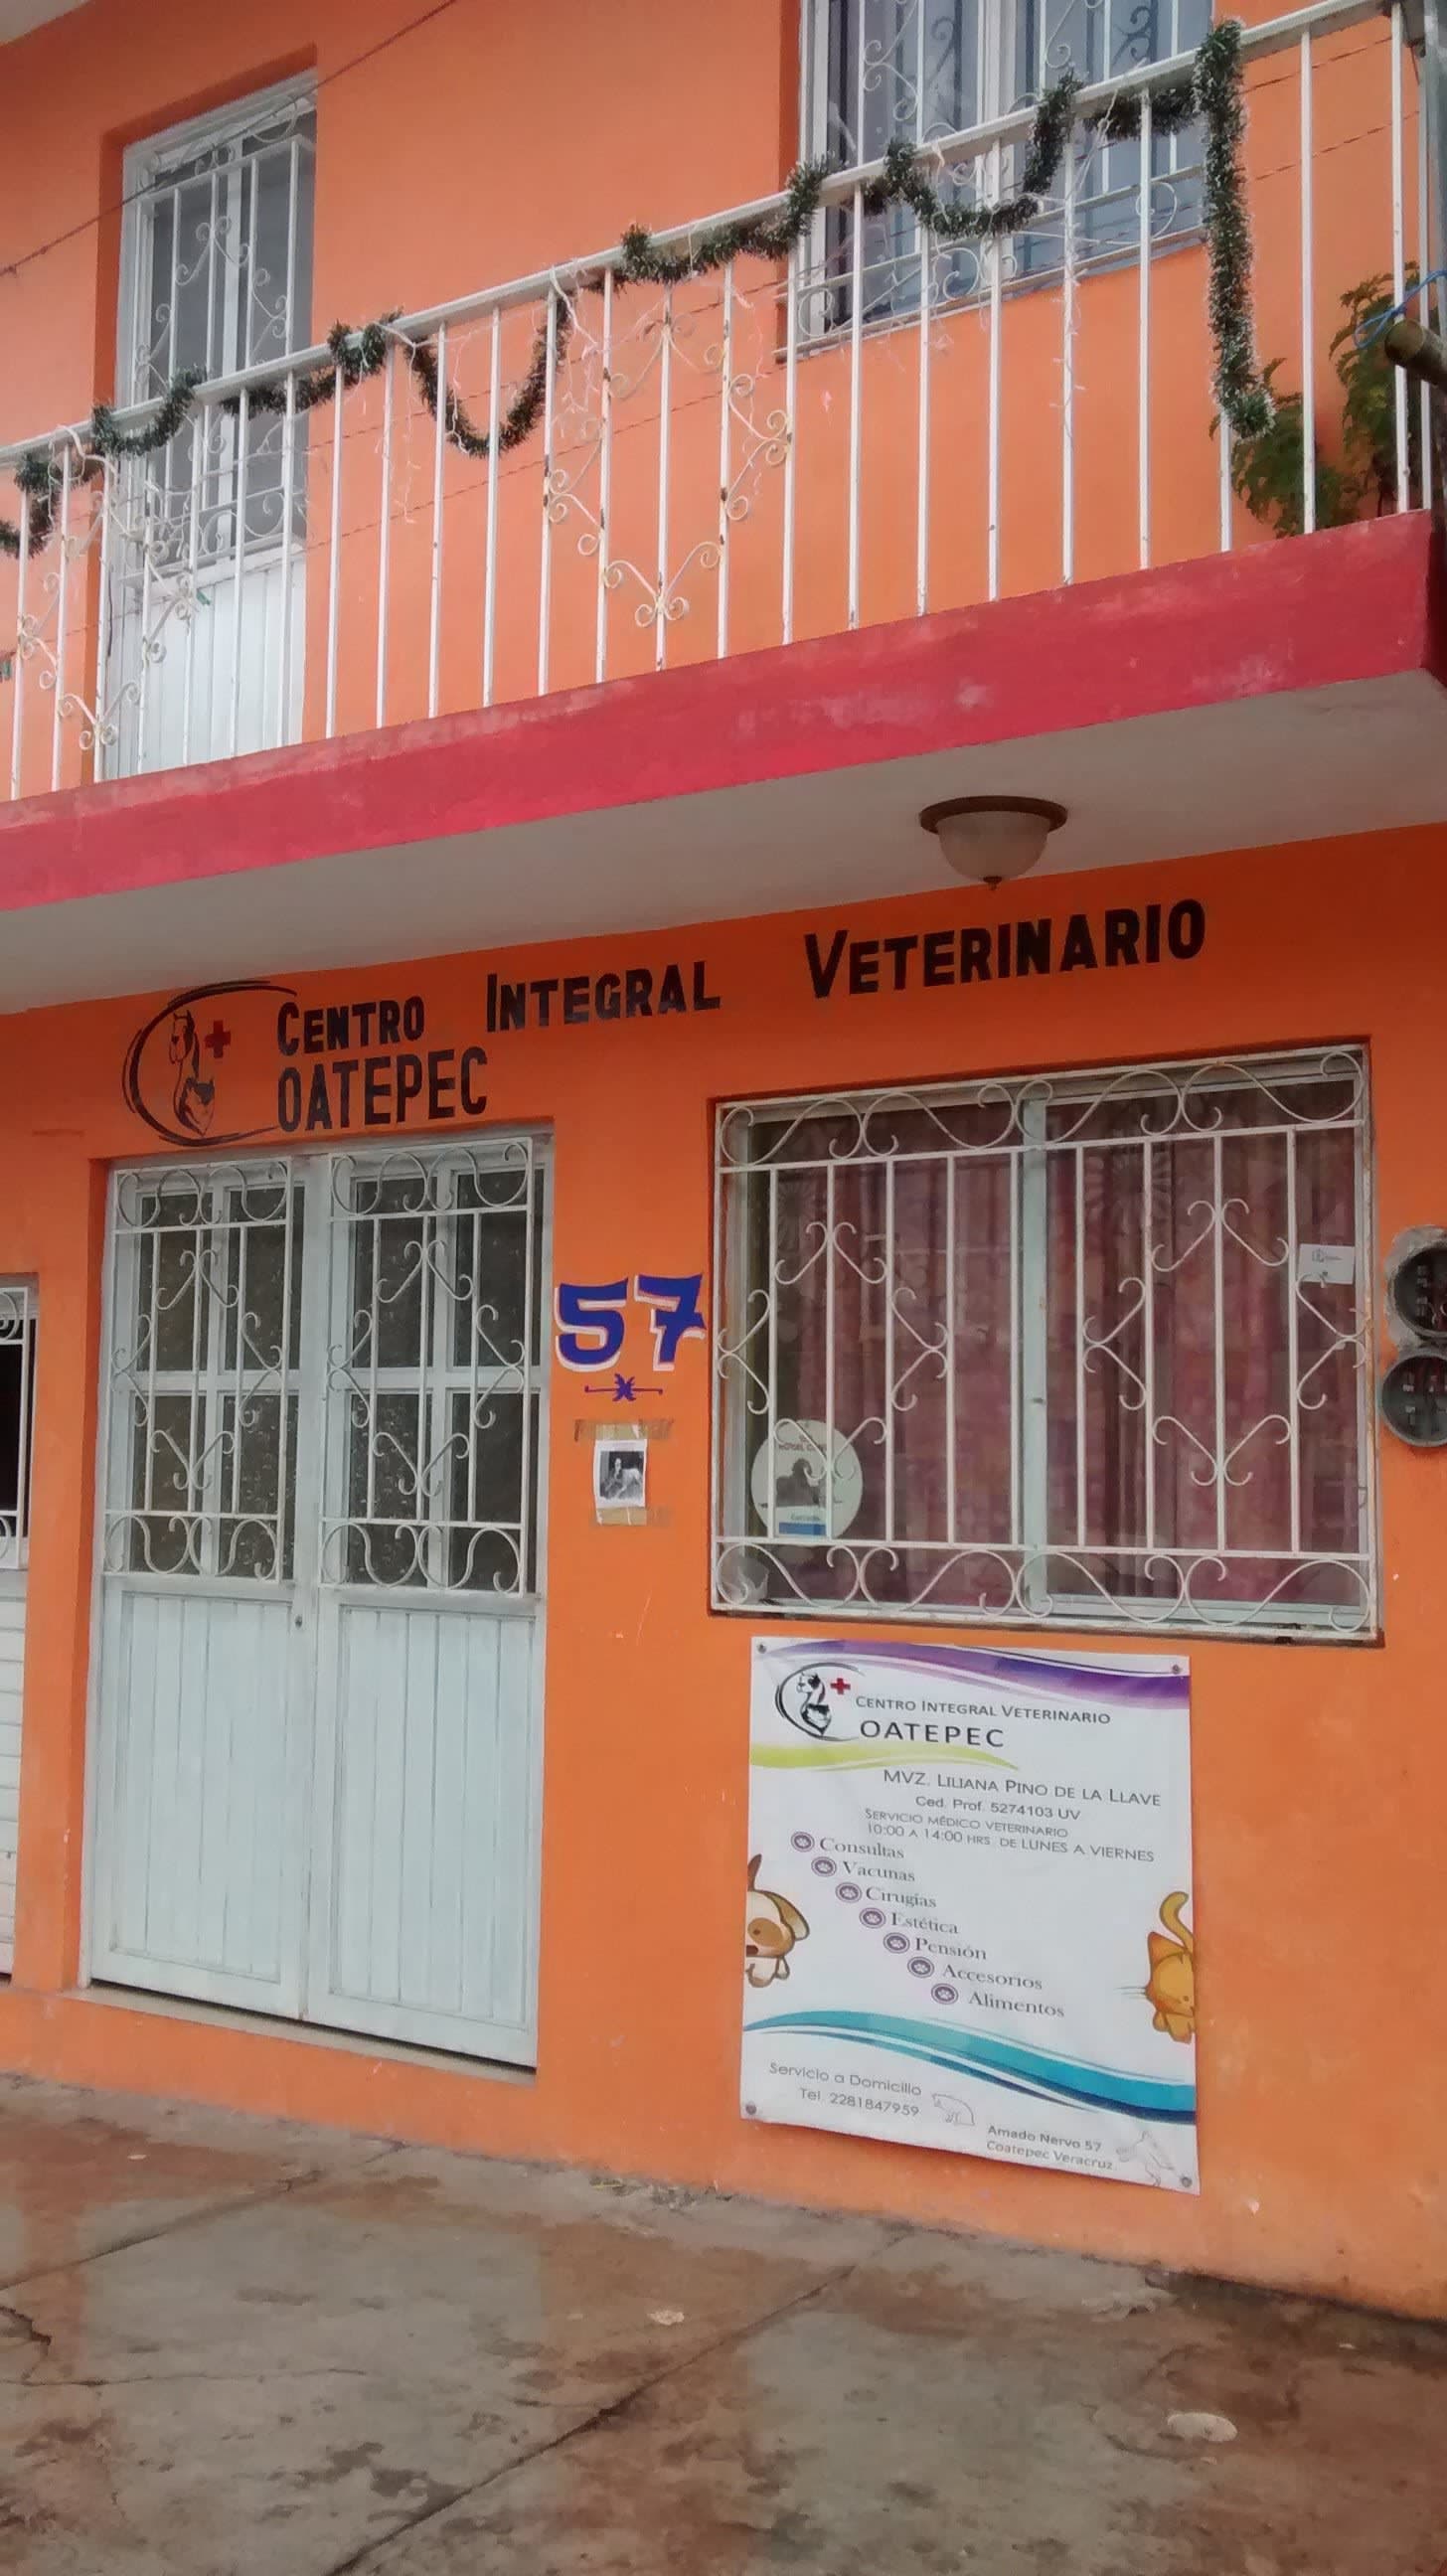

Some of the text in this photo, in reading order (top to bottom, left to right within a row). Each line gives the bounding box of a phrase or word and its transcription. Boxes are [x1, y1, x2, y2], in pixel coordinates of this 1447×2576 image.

[277, 898, 1206, 1056] CENTRO INTEGRAL VETERINARIO
[277, 1047, 489, 1133] OATEPEC
[554, 1273, 707, 1372] 57
[856, 1695, 1111, 1724] CENTRO INTEGRAL VETERINARIO
[860, 1719, 1004, 1747] OATEPEC
[937, 1773, 999, 1791] LILIANA
[1006, 1779, 1048, 1796] PINO
[1054, 1786, 1075, 1799] DE
[1082, 1789, 1102, 1801] LA
[1109, 1789, 1161, 1806] LLAVE
[865, 1808, 1068, 1838] SERVICIO MÉDICO VETERINARIO
[991, 1803, 1053, 1818] 5274103
[1058, 1809, 1081, 1821] UV
[820, 1838, 905, 1858] Consultas
[867, 1823, 904, 1838] 10:00
[908, 1829, 918, 1838] A
[924, 1829, 963, 1843] 14:00
[1000, 1838, 1017, 1849] DE
[1022, 1840, 1068, 1853] LUNES
[1073, 1845, 1085, 1854] A
[1090, 1846, 1155, 1862] VIERNES
[843, 1860, 916, 1882] Vacunas
[891, 1911, 959, 1934] Estética
[914, 1937, 988, 1961] Pensión
[941, 1964, 1044, 1990] Accesorios
[968, 1991, 1066, 2018] Alimentos
[769, 2061, 830, 2083] Servicio
[834, 2073, 846, 2084] a
[829, 2092, 920, 2118] 2281847959
[987, 2125, 1103, 2153] Amado Nervo 57
[986, 2140, 1113, 2171] Coatepec Veracruz
